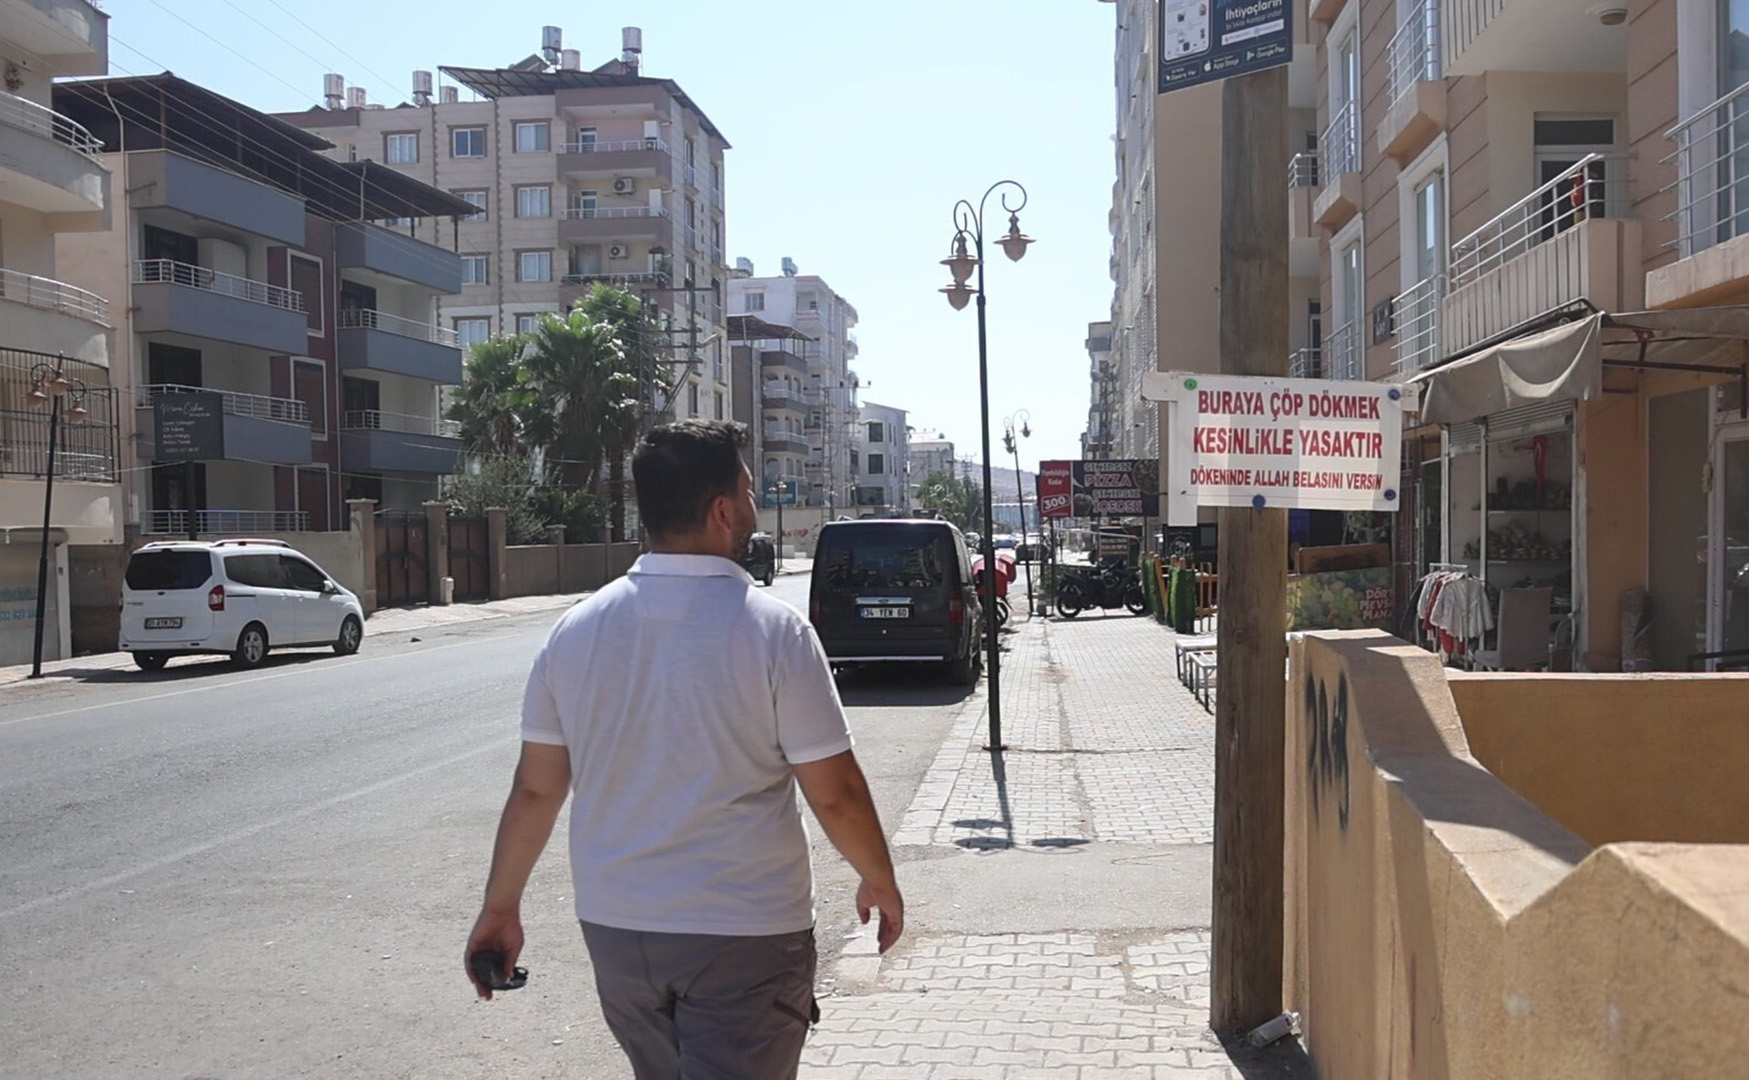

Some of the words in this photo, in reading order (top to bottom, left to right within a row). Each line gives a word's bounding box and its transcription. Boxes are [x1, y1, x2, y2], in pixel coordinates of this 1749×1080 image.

[1198, 390, 1265, 415] BURAYA
[1270, 388, 1304, 421] ÇÖP
[1308, 390, 1381, 419] DÖKMEK
[1298, 429, 1382, 458] YASAKTIR
[1253, 470, 1290, 487] ALLAH
[1292, 471, 1343, 489] BELASINI
[1044, 496, 1066, 510] 300
